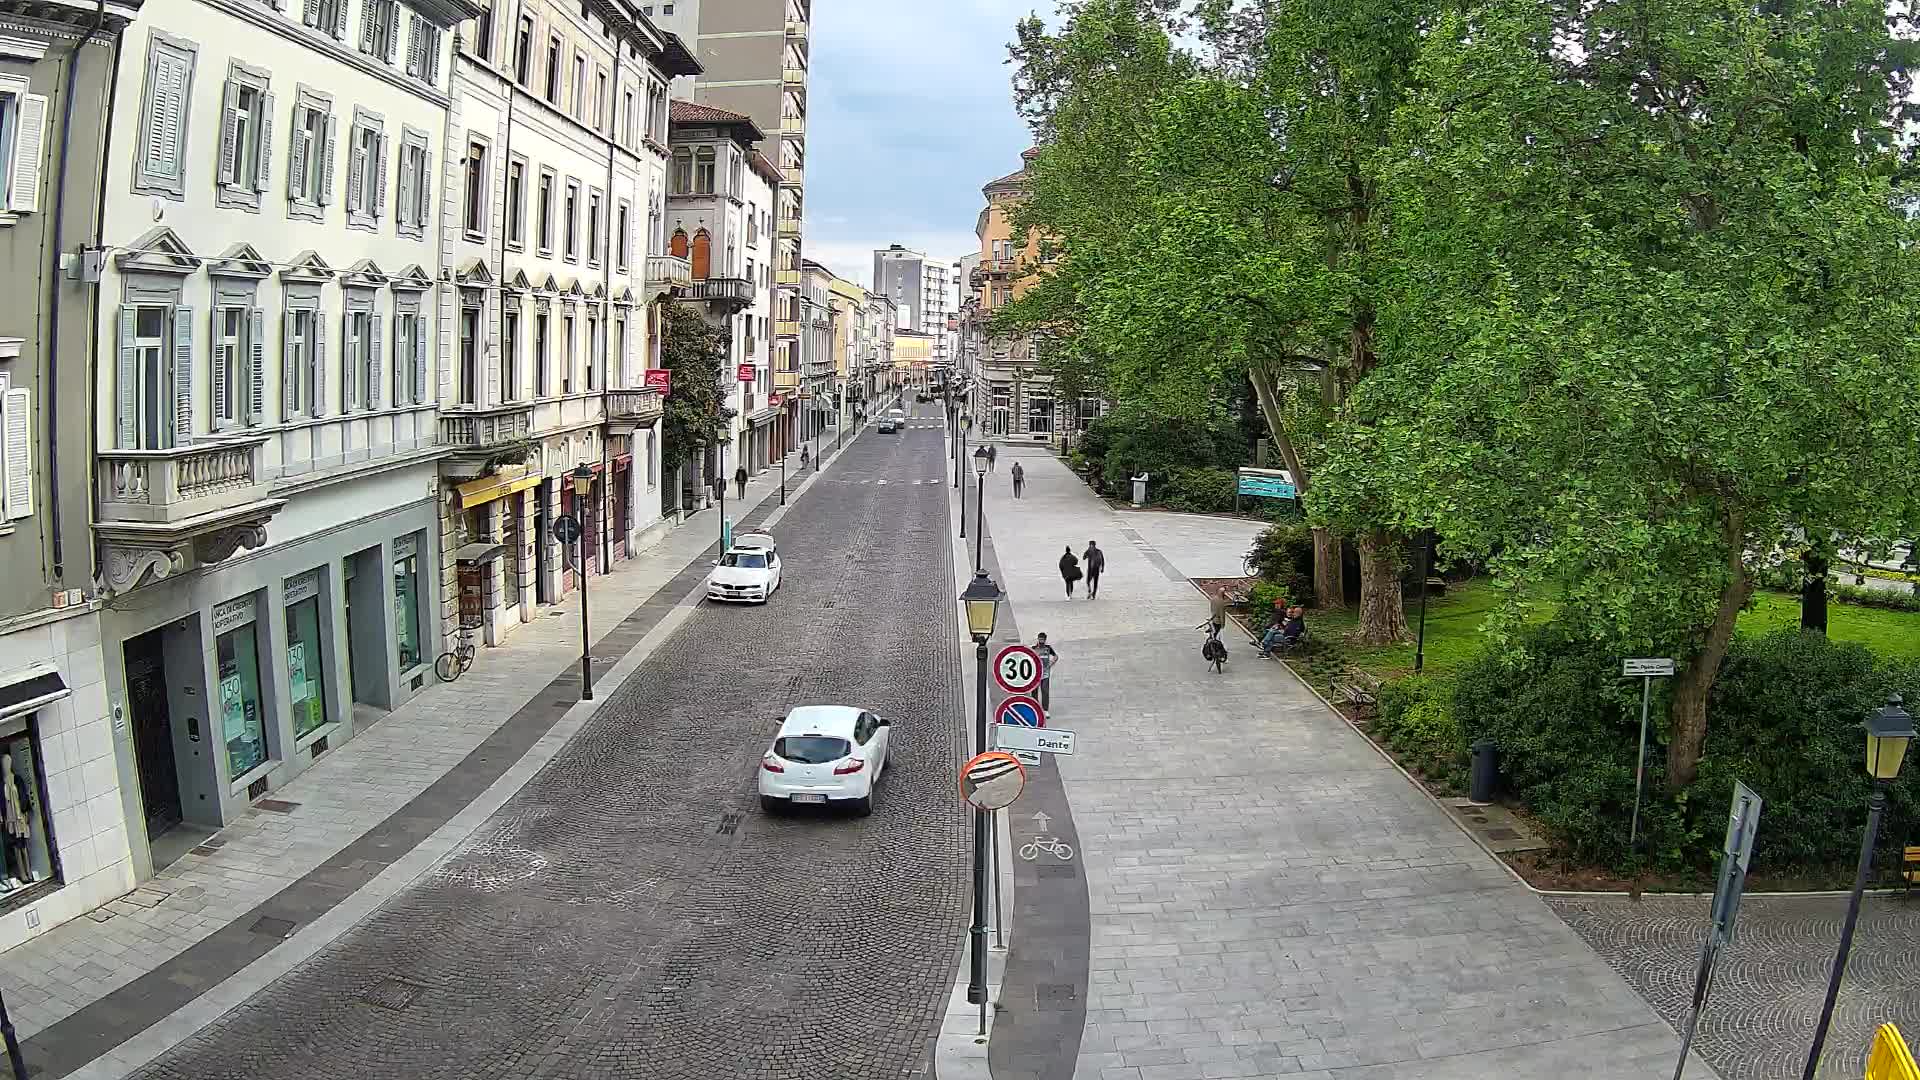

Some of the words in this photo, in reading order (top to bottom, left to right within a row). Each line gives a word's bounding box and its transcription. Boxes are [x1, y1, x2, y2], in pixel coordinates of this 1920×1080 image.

[1005, 657, 1033, 681] 30
[222, 678, 240, 700] 130
[1037, 738, 1069, 750] Dante
